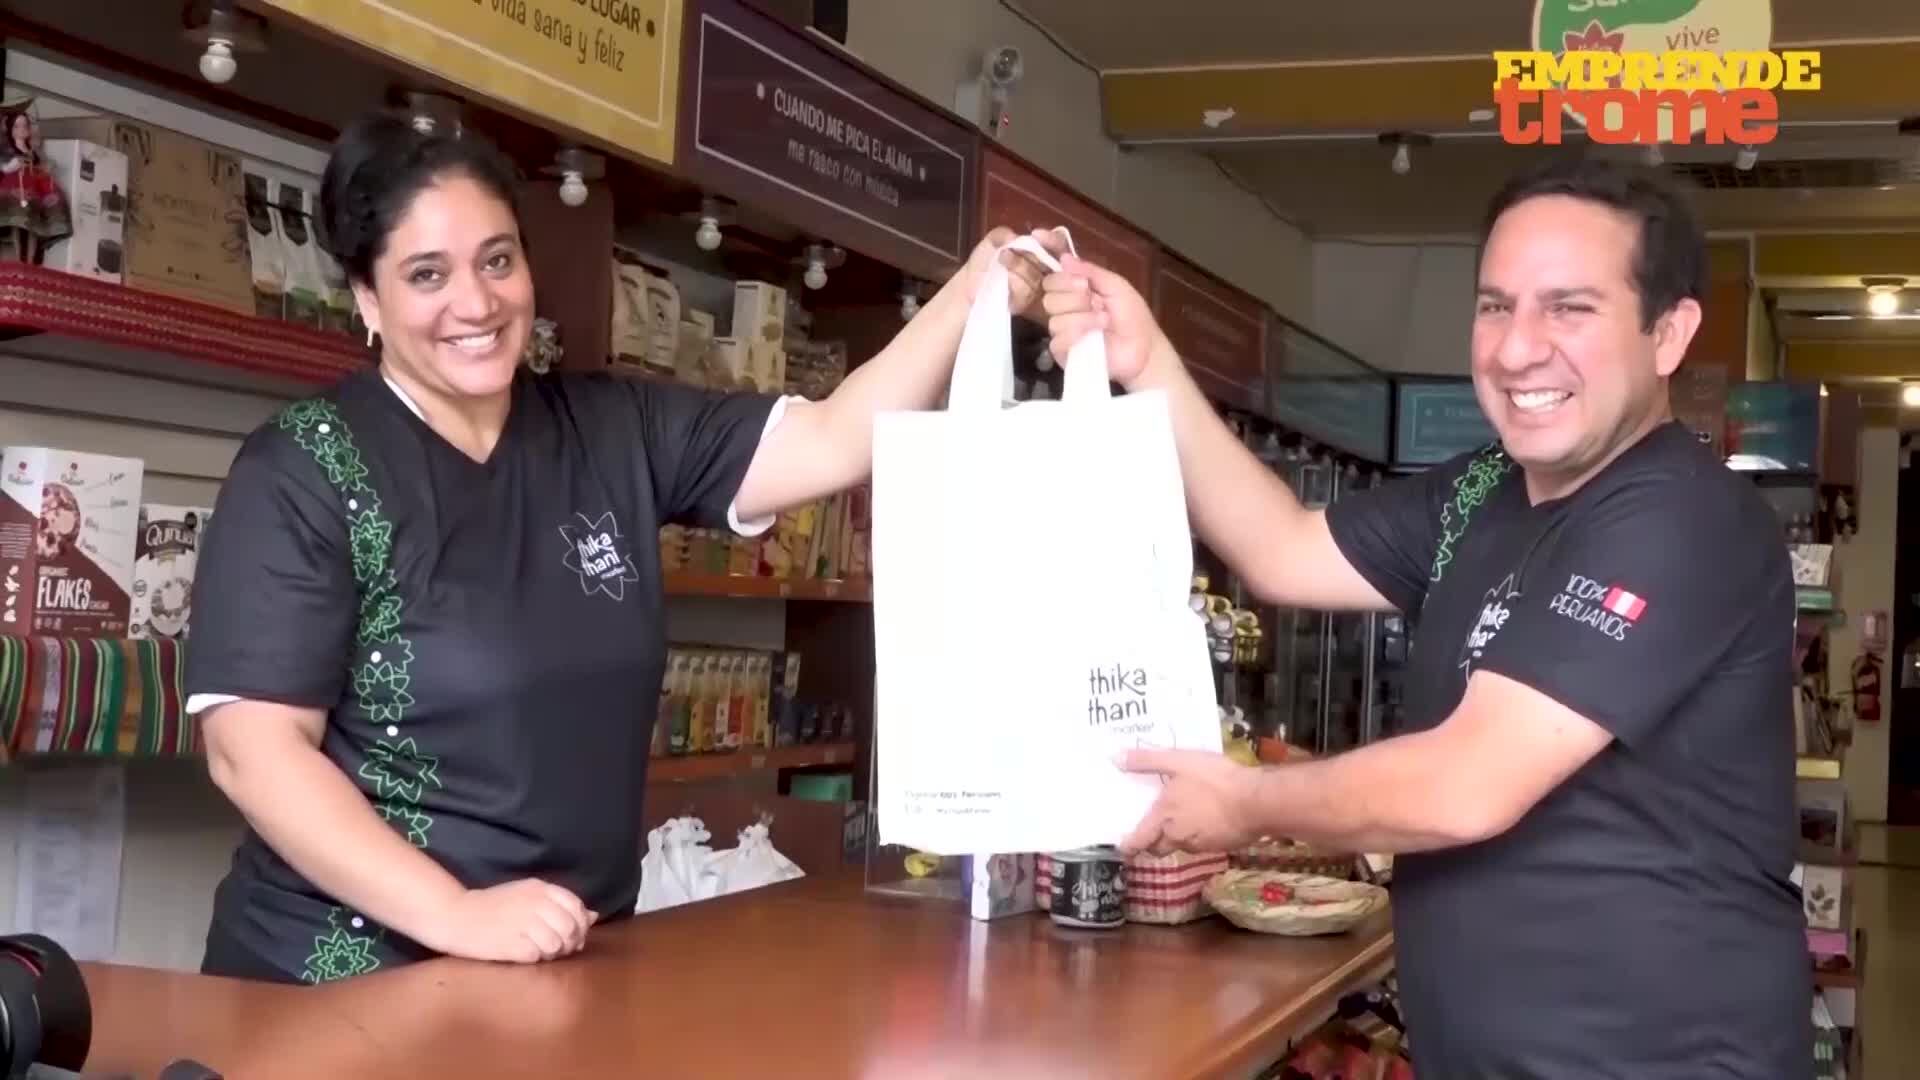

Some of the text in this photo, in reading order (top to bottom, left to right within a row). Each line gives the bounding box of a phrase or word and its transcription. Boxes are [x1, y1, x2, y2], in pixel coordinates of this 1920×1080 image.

[534, 8, 572, 47] sana
[578, 31, 588, 65] y
[595, 28, 625, 72] feliz
[1665, 25, 1720, 51] vive
[774, 87, 913, 178] CUANDO ME PICA EL ALMA
[787, 138, 805, 164] me
[809, 148, 840, 180] rasco
[843, 164, 863, 189] con
[577, 532, 613, 558] thika
[580, 546, 621, 577] thani
[36, 577, 92, 610] FLAKES
[1566, 573, 1608, 601] 100%
[1550, 593, 1632, 641] PERUANOS
[1089, 663, 1147, 696] thika
[1088, 697, 1147, 726] thani
